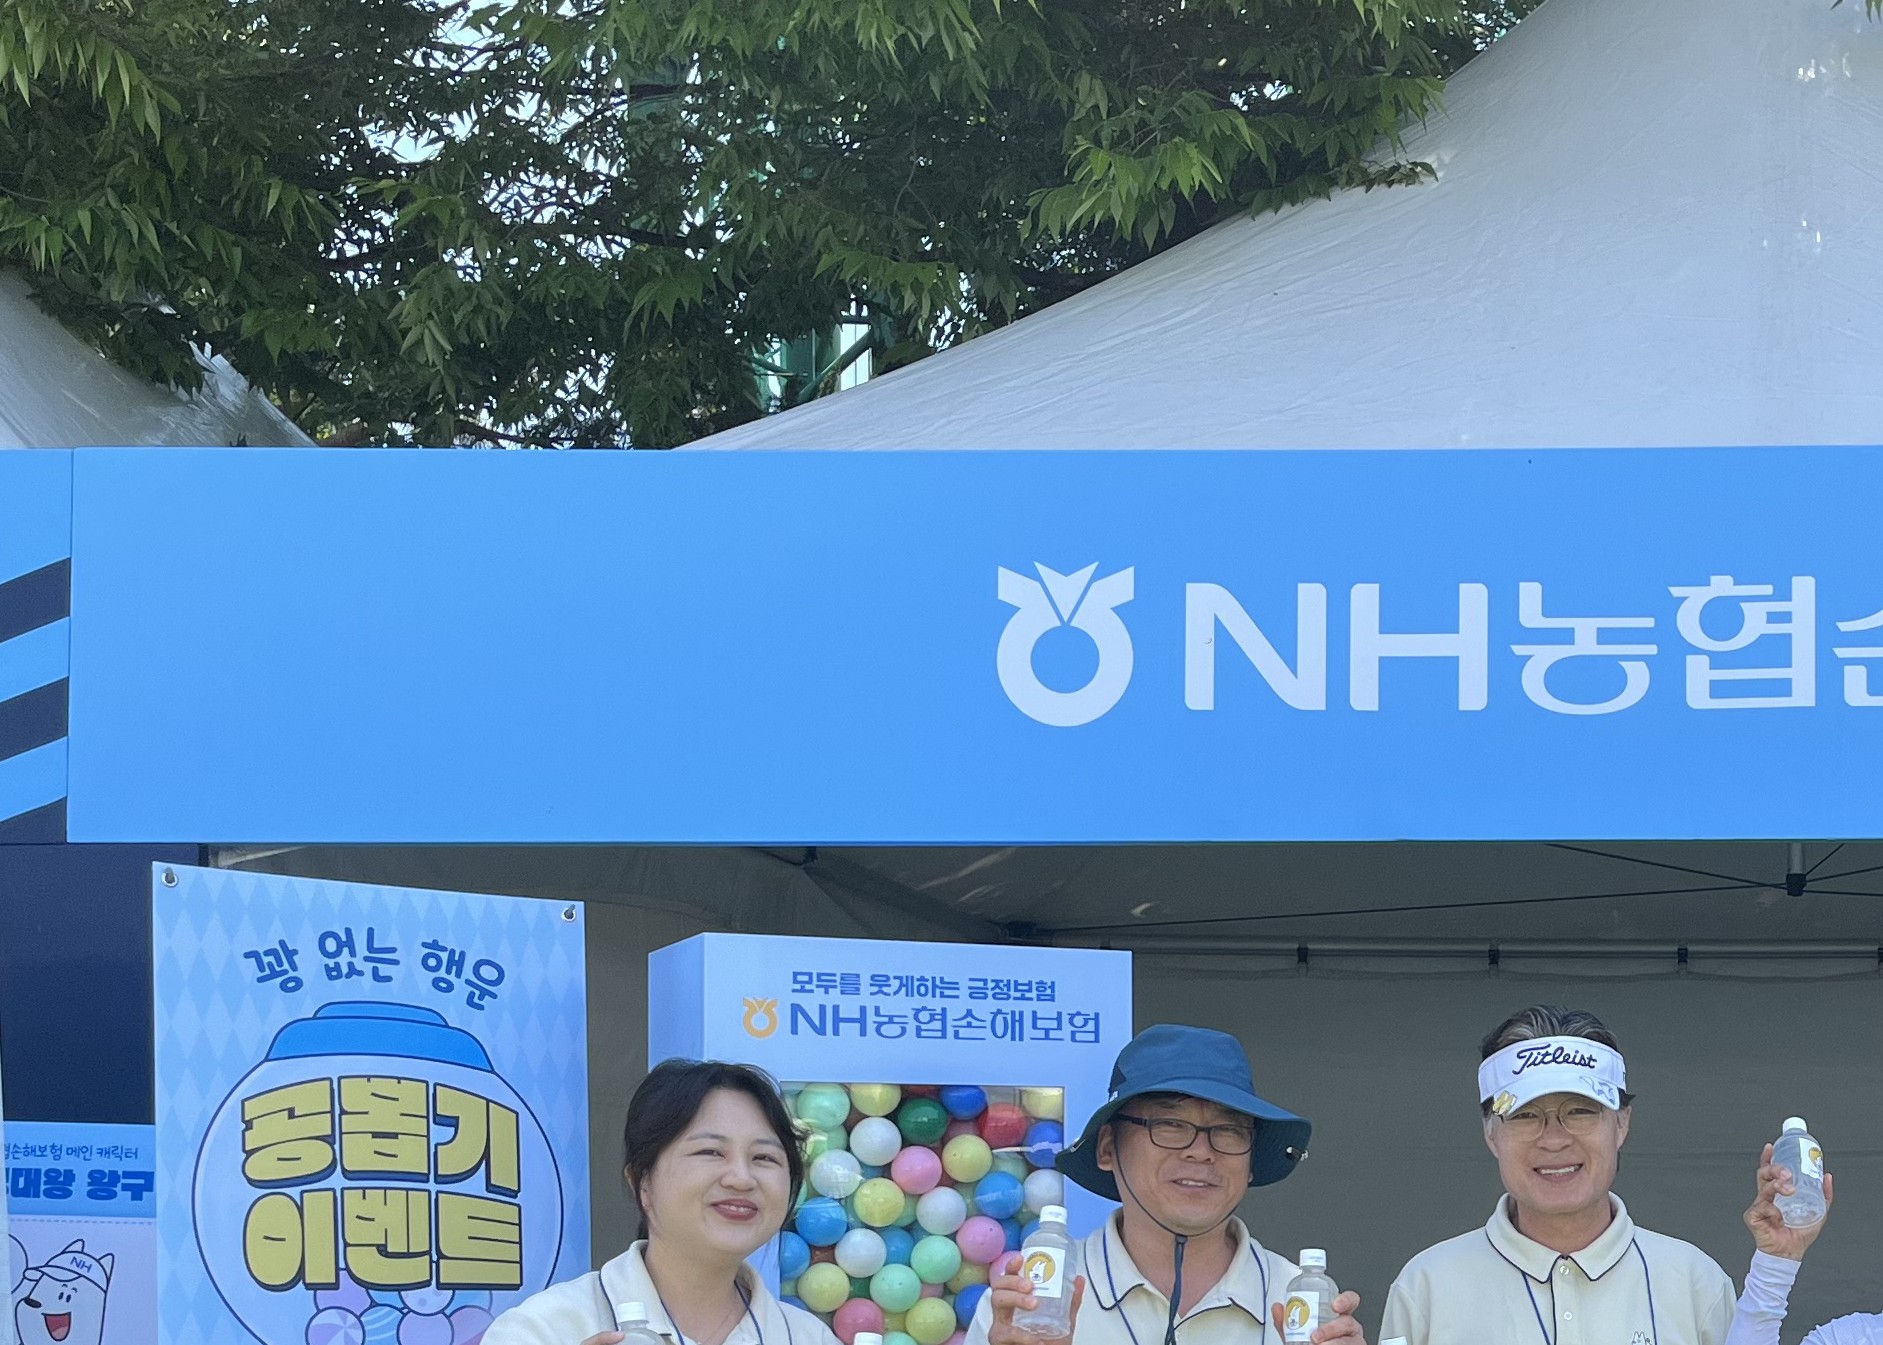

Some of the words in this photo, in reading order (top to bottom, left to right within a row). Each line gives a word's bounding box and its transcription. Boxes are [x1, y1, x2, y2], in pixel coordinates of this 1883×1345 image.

[243, 938, 304, 993] 꽝
[317, 927, 401, 983] 없는
[420, 938, 506, 1011] 행운
[791, 971, 862, 997] 모두를
[868, 973, 960, 1000] 웃게하는
[967, 978, 1057, 1003] 긍정보험
[790, 1002, 1102, 1044] NH농협손해보험
[1511, 1043, 1598, 1075] Titleist
[66, 1145, 93, 1161] 메인
[96, 1146, 139, 1161] 캐릭터
[240, 1075, 521, 1199] 공뽑기
[5, 1167, 76, 1200] 대왕
[86, 1169, 155, 1202] 왕구
[243, 1187, 523, 1292] 이벤트
[70, 1256, 93, 1274] NH
